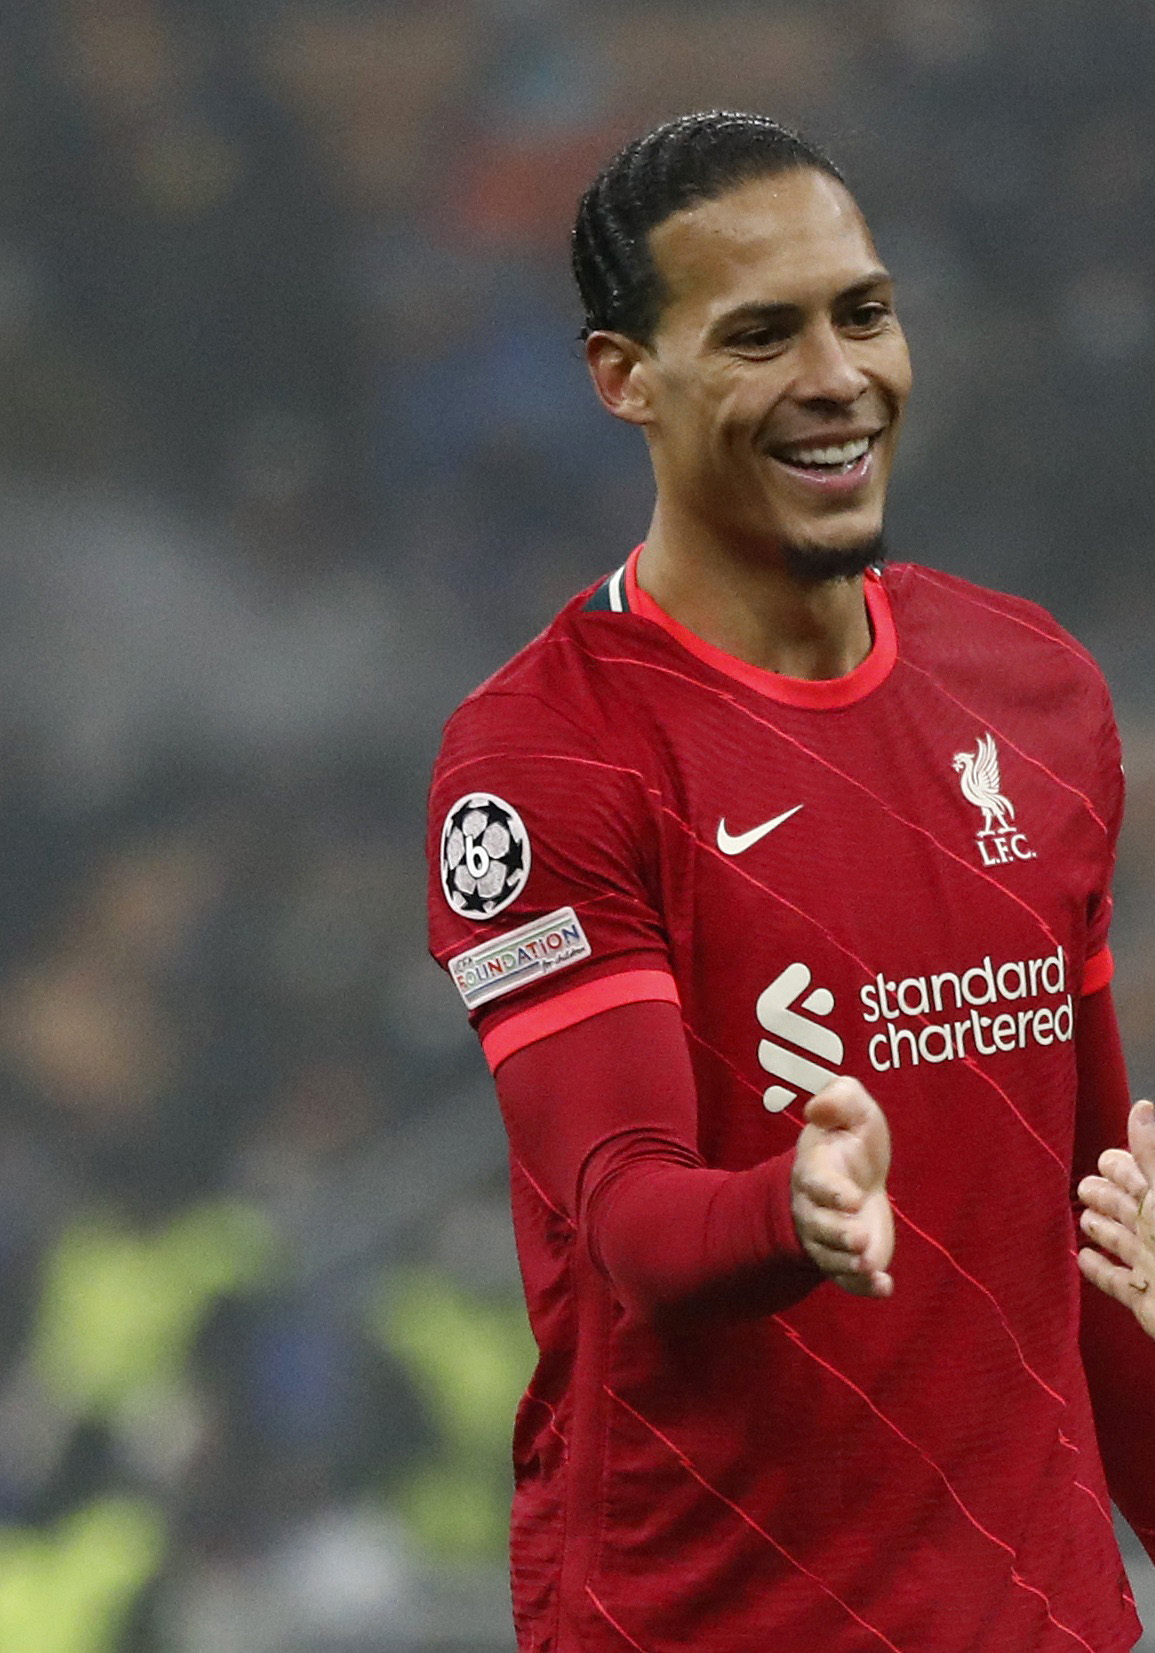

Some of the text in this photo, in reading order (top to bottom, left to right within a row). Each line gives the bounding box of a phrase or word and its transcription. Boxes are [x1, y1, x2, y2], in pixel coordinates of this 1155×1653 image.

[977, 833, 1037, 867] L.F.C.
[860, 945, 1065, 1022] standard
[868, 994, 1073, 1072] chartered
